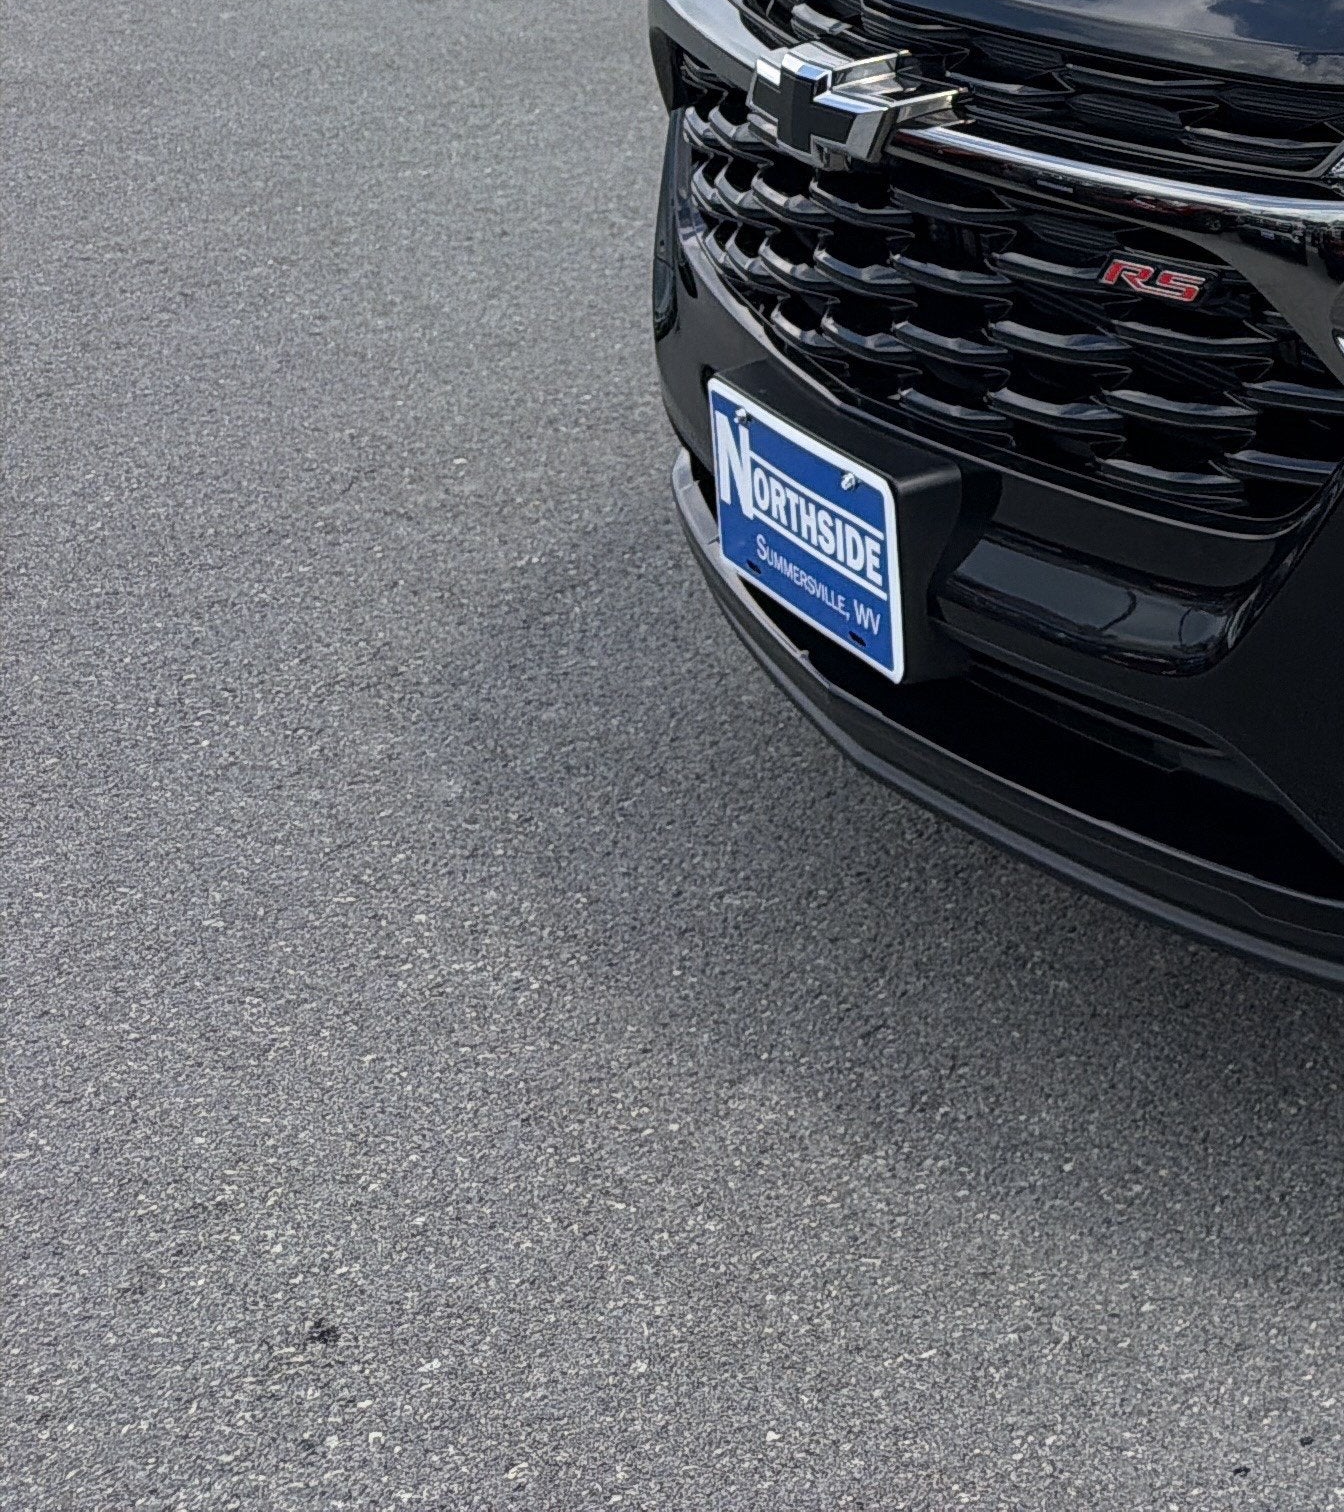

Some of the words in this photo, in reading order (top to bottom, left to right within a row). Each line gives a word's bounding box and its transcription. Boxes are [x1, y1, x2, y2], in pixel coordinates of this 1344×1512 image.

[1099, 258, 1206, 302] RS
[714, 408, 884, 587] NORTHSIDE
[755, 533, 851, 622] SUMMERSVILLE,
[853, 598, 882, 636] WV
